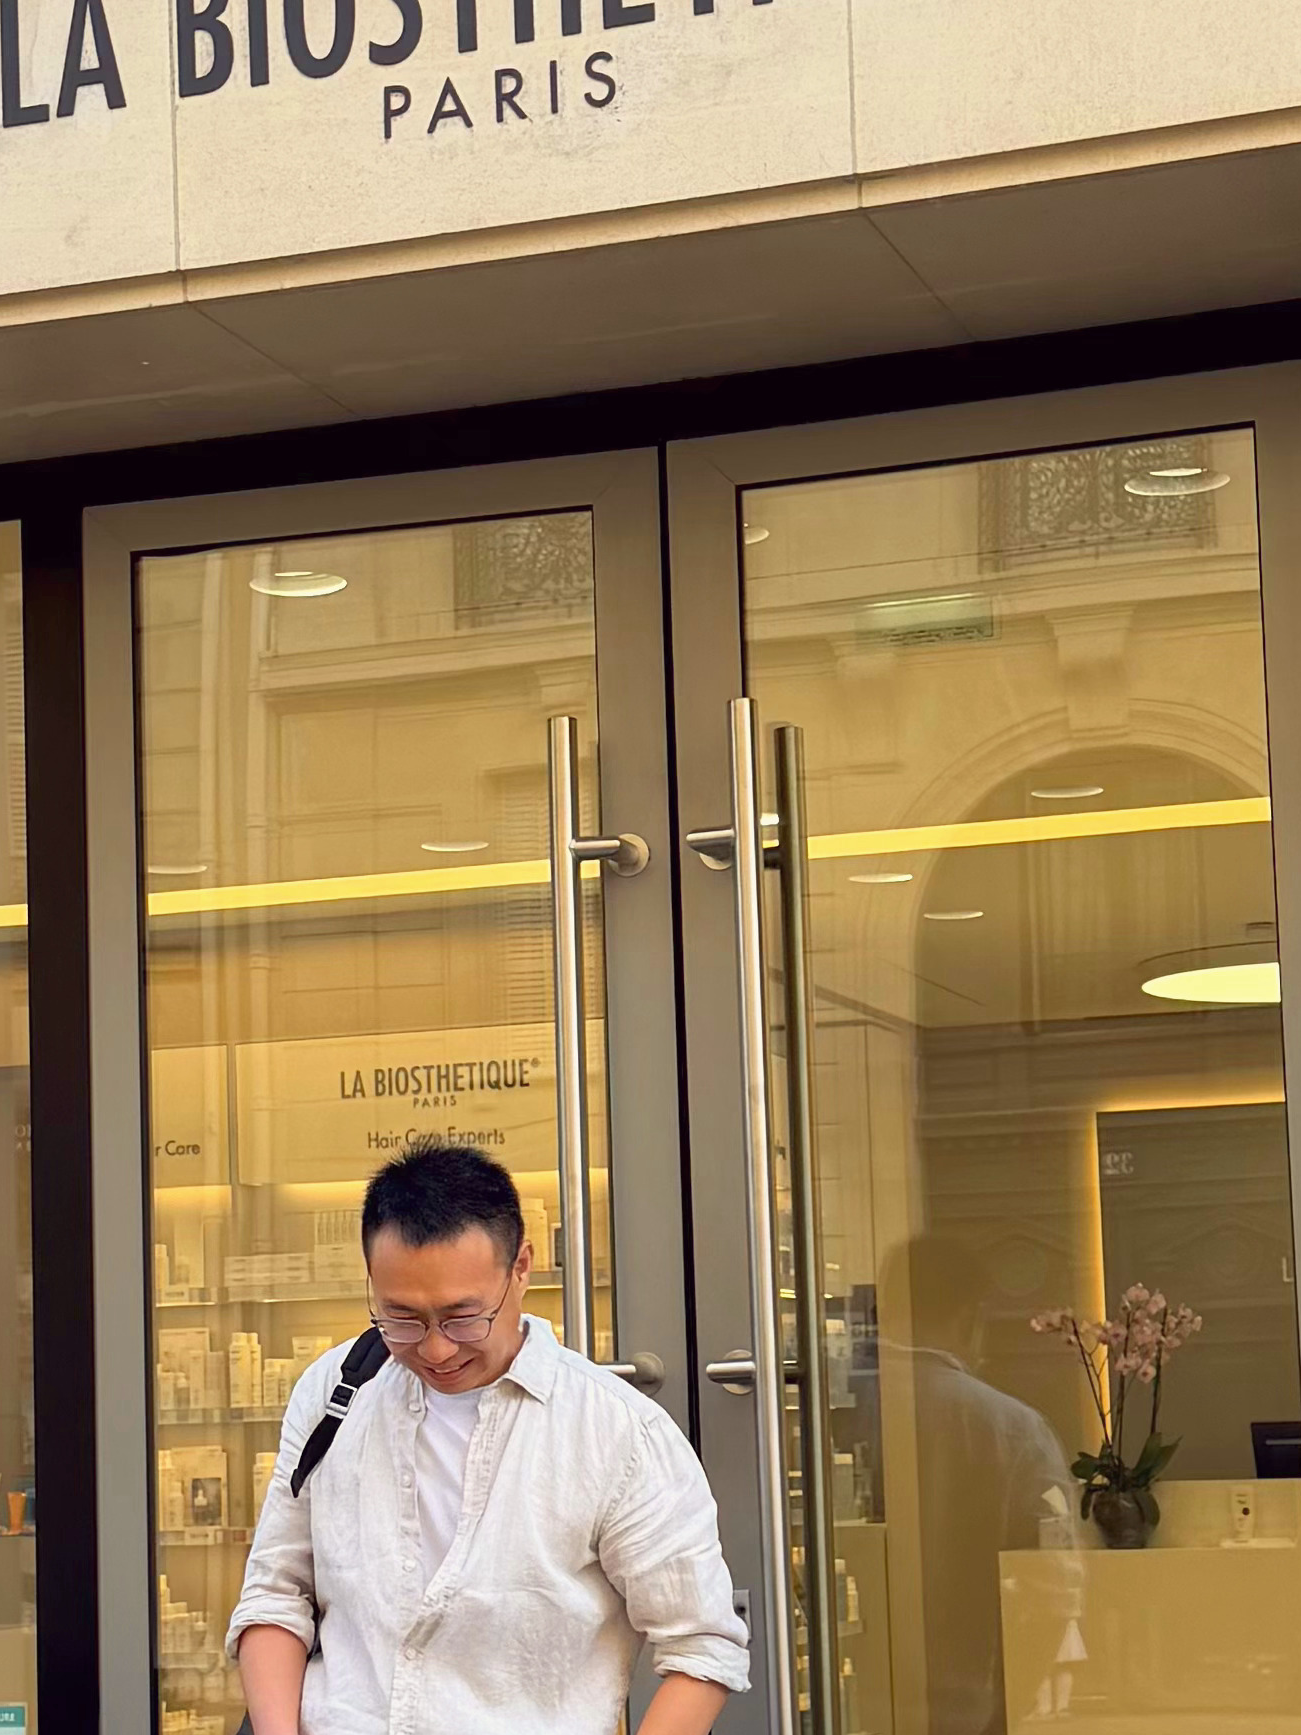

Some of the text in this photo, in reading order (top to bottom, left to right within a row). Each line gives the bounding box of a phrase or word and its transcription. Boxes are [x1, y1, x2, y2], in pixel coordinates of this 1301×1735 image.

[384, 52, 615, 139] PARIS
[340, 1070, 366, 1099] LA
[413, 1095, 457, 1109] PARIS
[165, 1140, 201, 1156] Care
[367, 1131, 402, 1149] Hair
